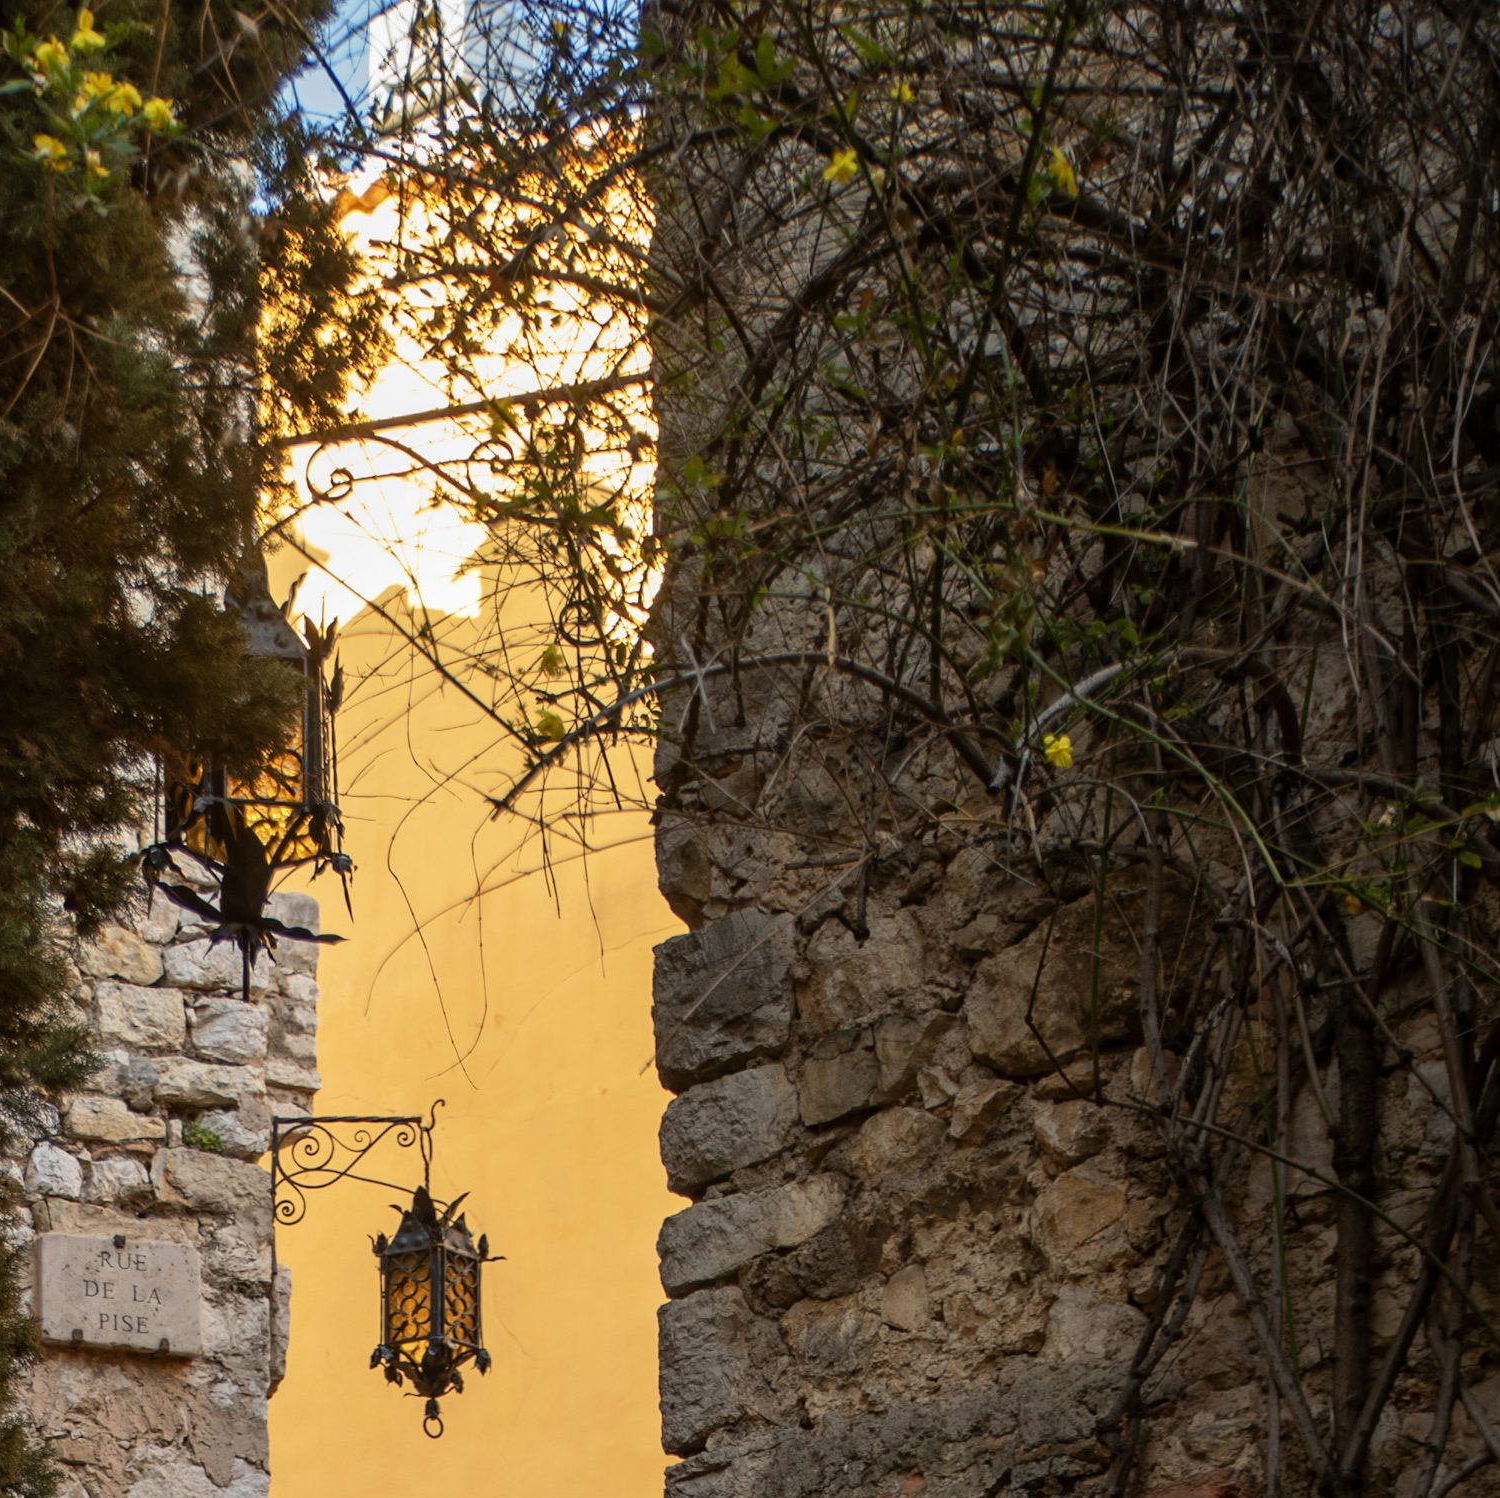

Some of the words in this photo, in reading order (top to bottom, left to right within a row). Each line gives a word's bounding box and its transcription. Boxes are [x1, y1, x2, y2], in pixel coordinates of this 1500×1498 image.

[99, 1251, 148, 1272] RUE
[83, 1279, 115, 1300] DE
[132, 1284, 162, 1305] LA
[98, 1312, 150, 1334] PISE
